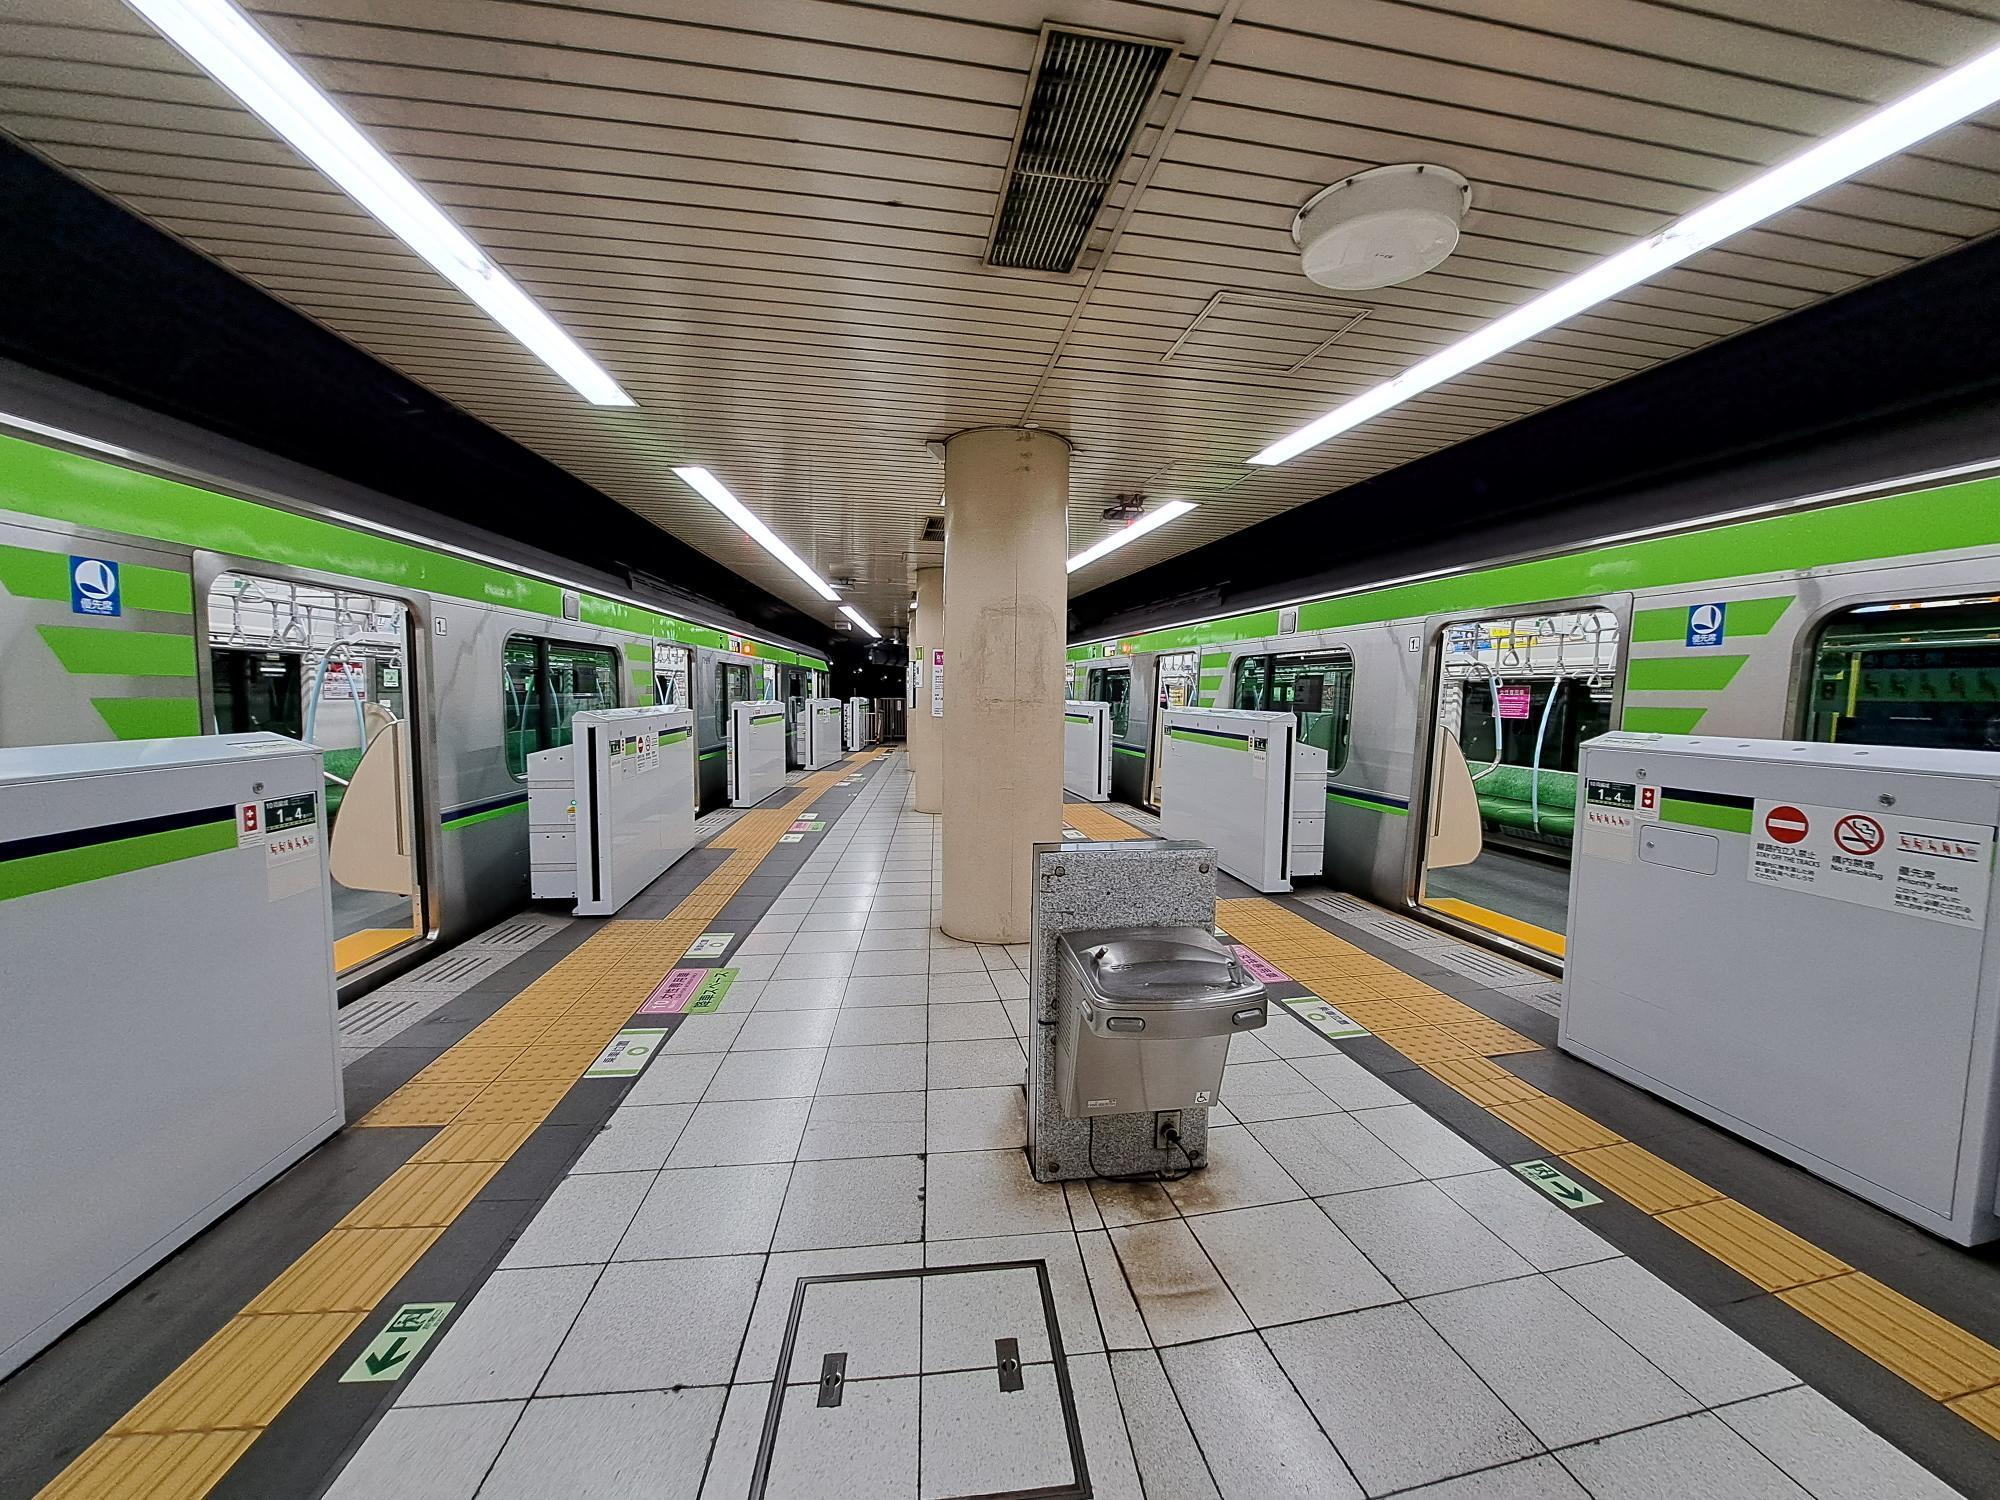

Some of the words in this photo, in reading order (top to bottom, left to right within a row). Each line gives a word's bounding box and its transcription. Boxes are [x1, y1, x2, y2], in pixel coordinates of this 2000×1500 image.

[1784, 855, 1795, 864] THE
[1796, 858, 1820, 868] TRACKS
[1830, 864, 1842, 873] No
[1845, 864, 1884, 880] Smoking
[1897, 875, 1933, 889] Priority
[1935, 882, 1959, 893] Seat
[694, 971, 730, 1008] 降車スペース
[652, 1000, 669, 1009] 10
